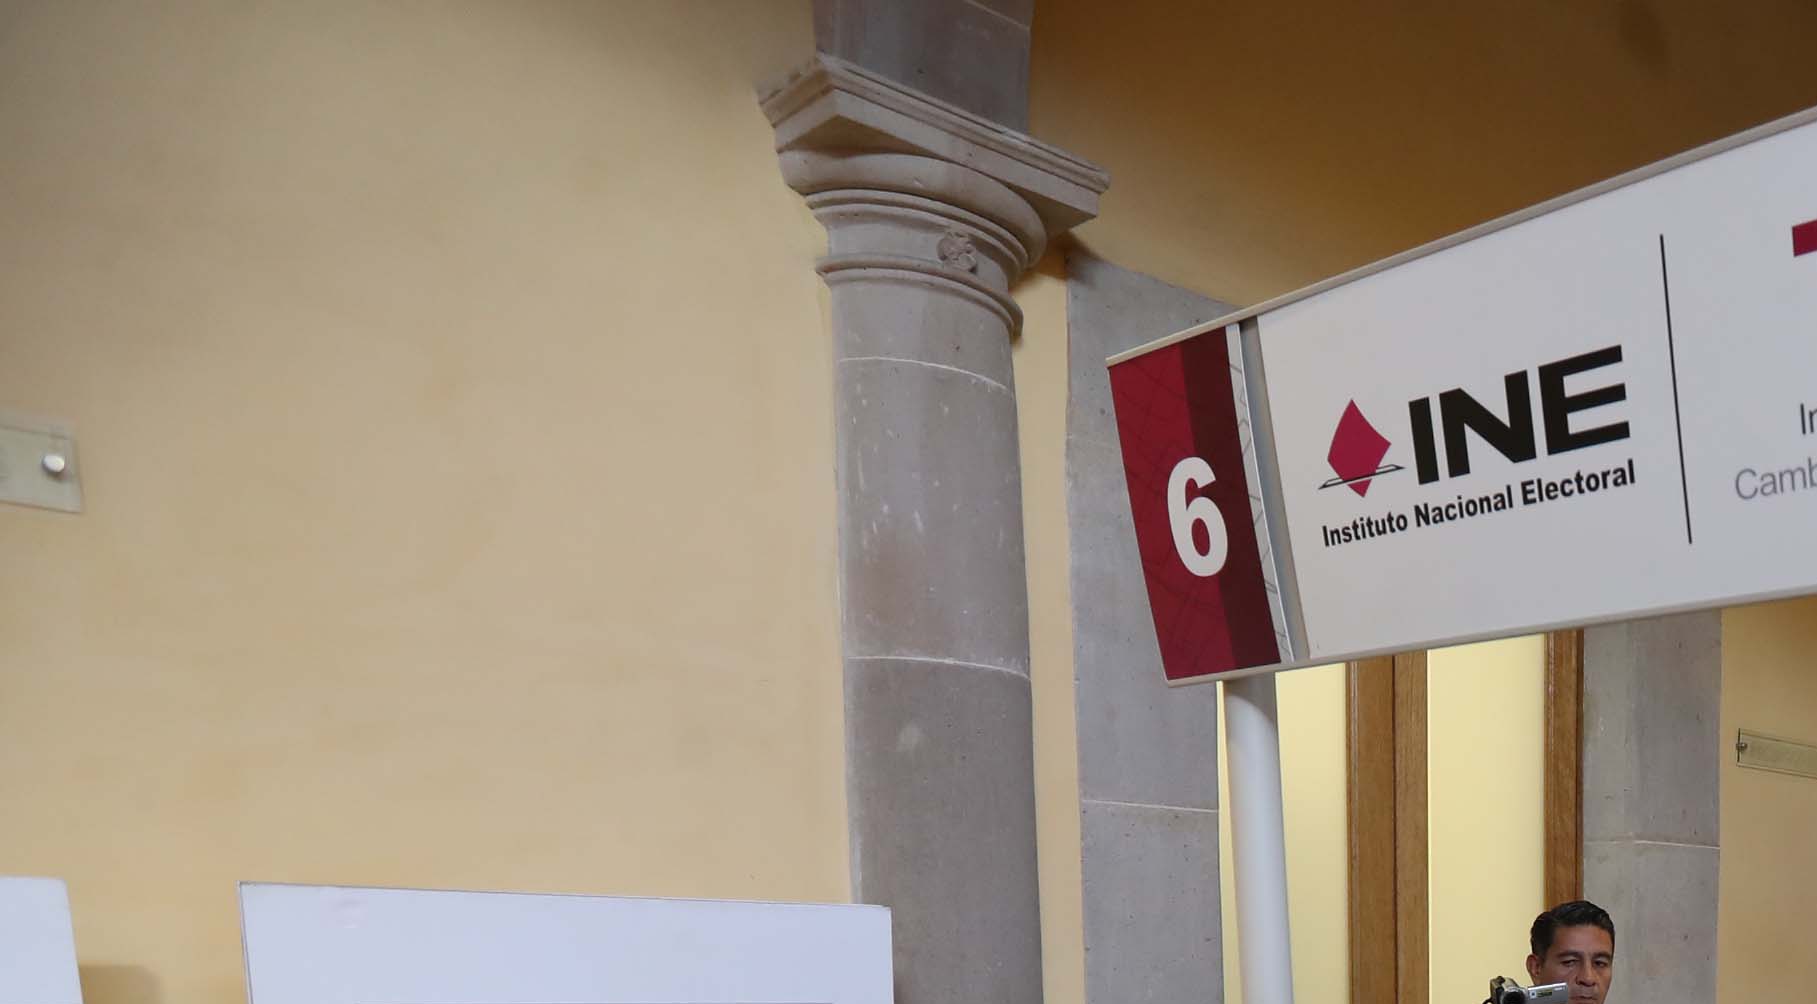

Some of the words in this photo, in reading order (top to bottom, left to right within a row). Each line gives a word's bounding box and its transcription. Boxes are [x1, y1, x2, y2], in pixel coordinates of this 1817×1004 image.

[1409, 345, 1630, 489] INE
[1166, 456, 1229, 577] 6
[1323, 512, 1407, 547] Instituto
[1414, 485, 1513, 527] Nacional
[1521, 459, 1635, 505] Electoral
